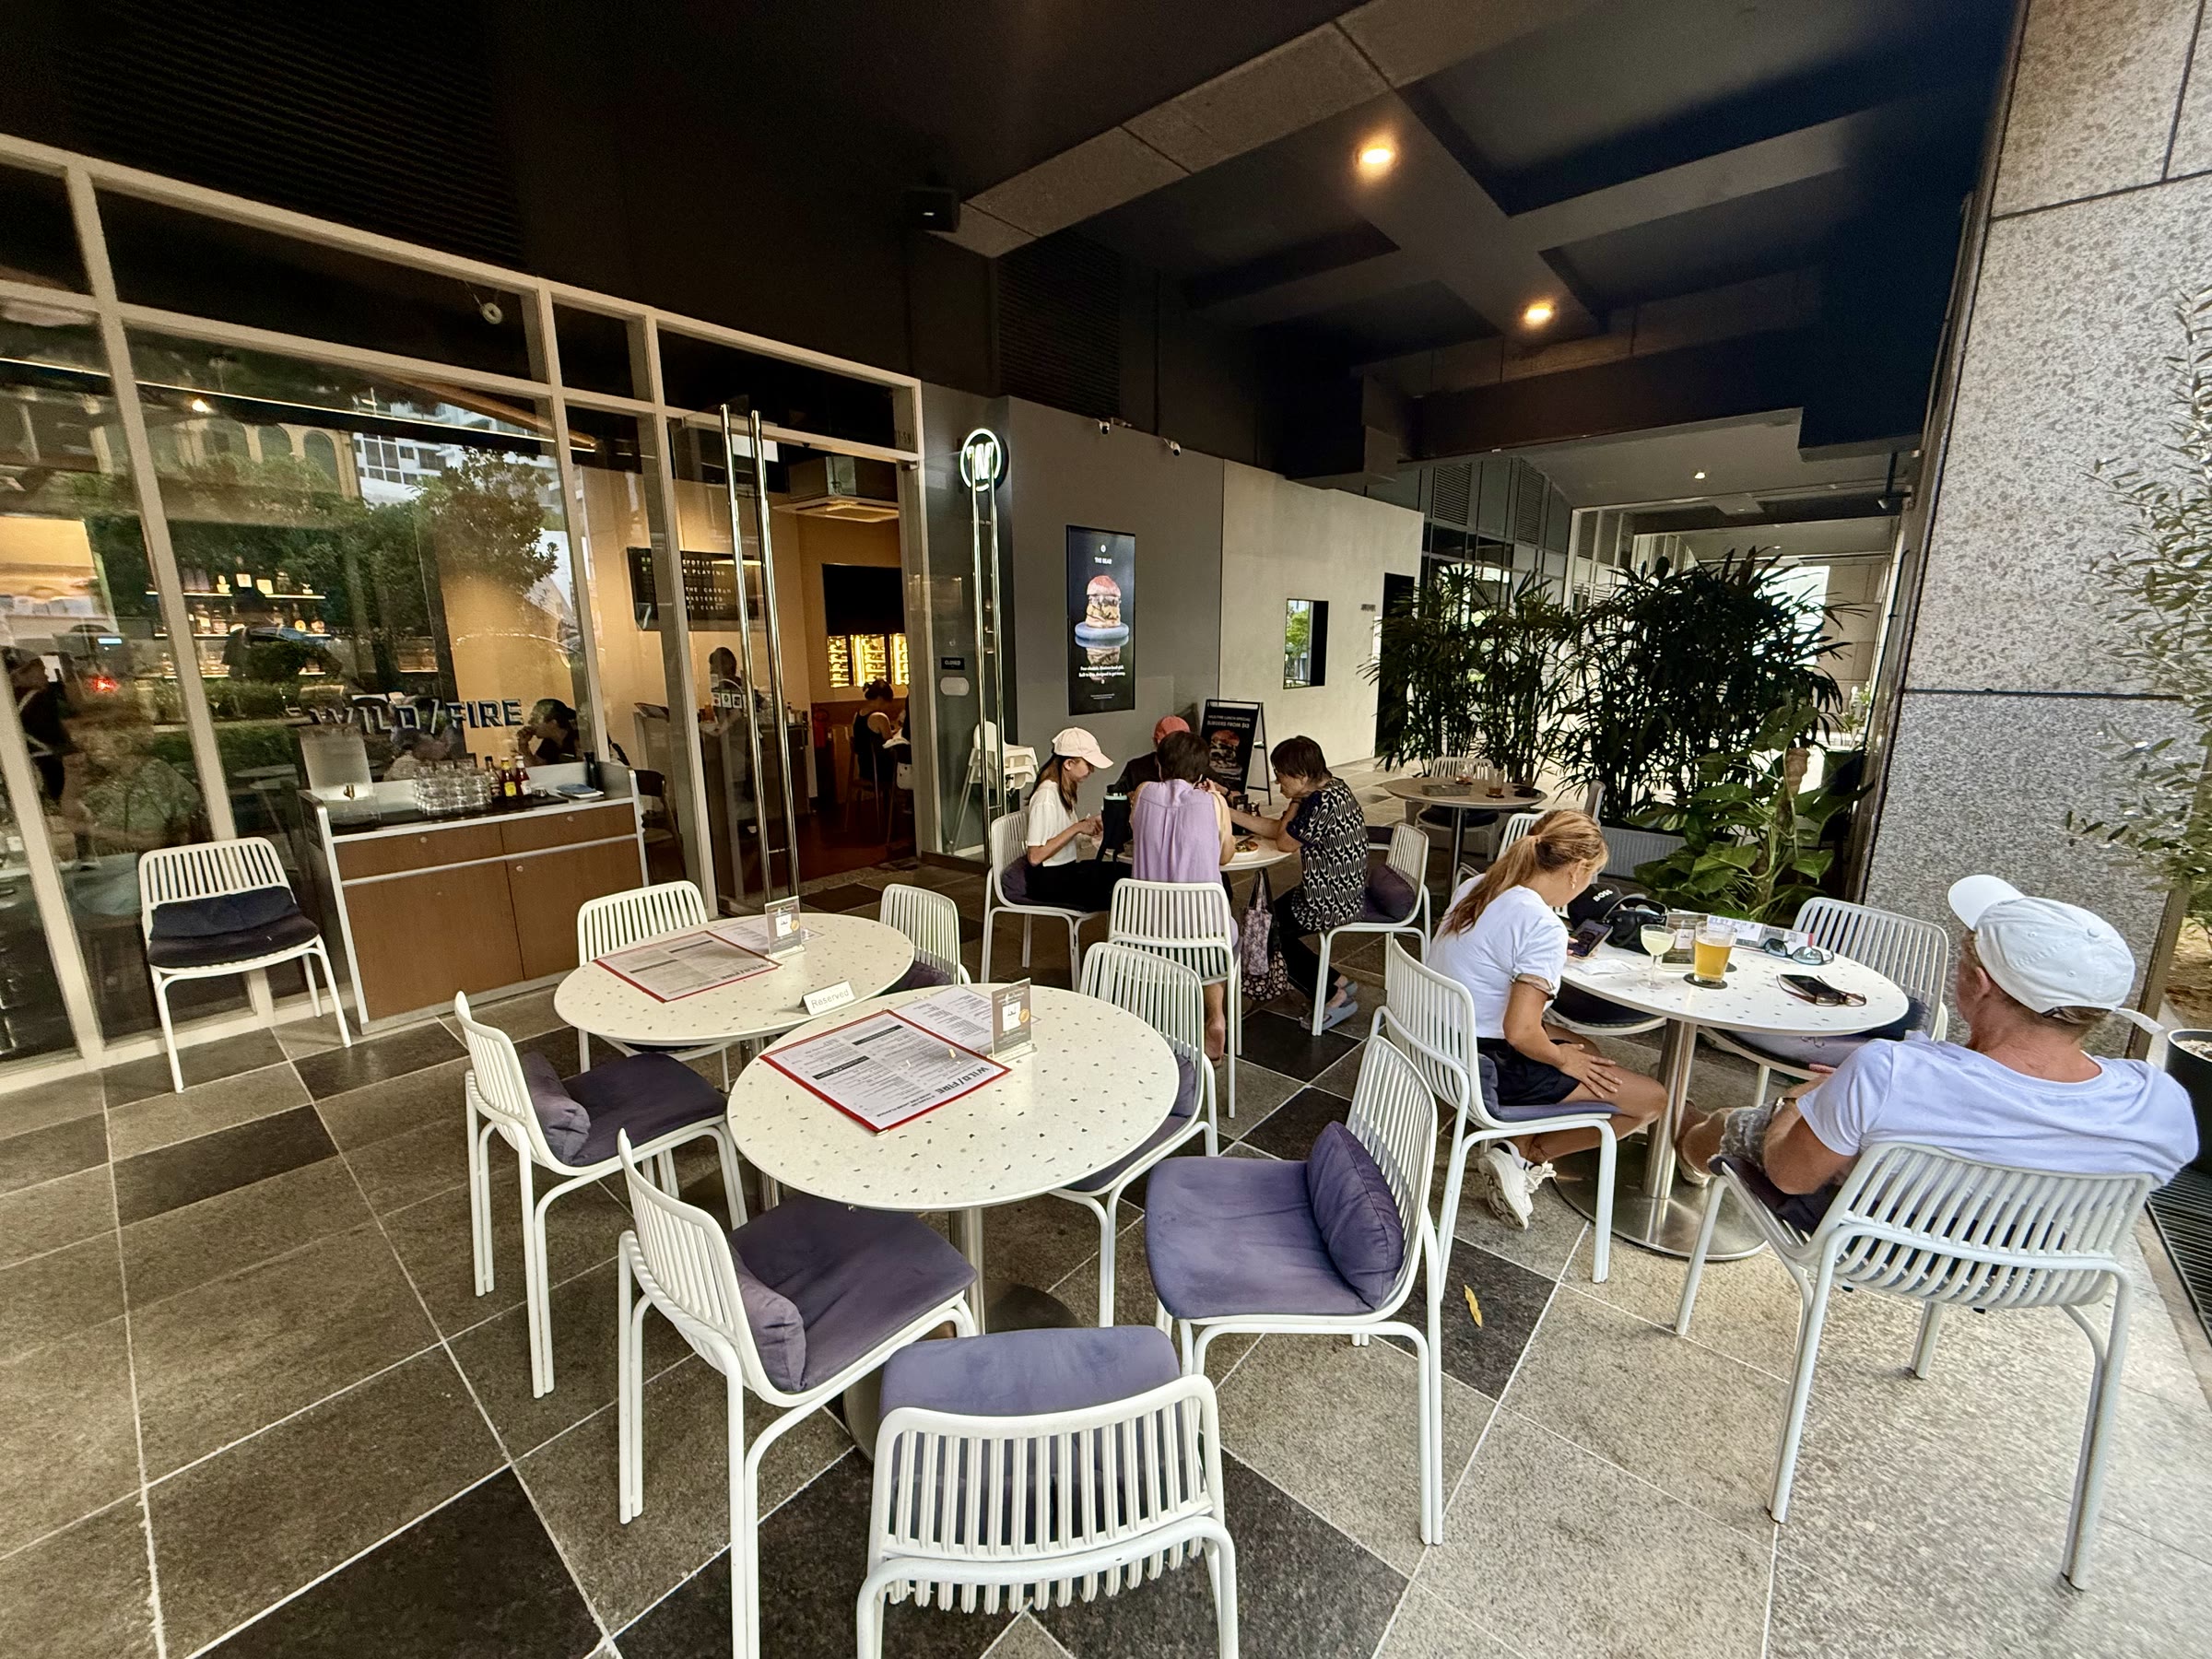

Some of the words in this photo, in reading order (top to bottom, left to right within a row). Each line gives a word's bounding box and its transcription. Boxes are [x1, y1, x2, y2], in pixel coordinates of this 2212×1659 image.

[307, 699, 524, 735] WILD/FIRE
[1592, 888, 1614, 902] BOSS
[811, 989, 849, 1008] Reserved
[935, 1066, 989, 1094] WILD/FIRE
